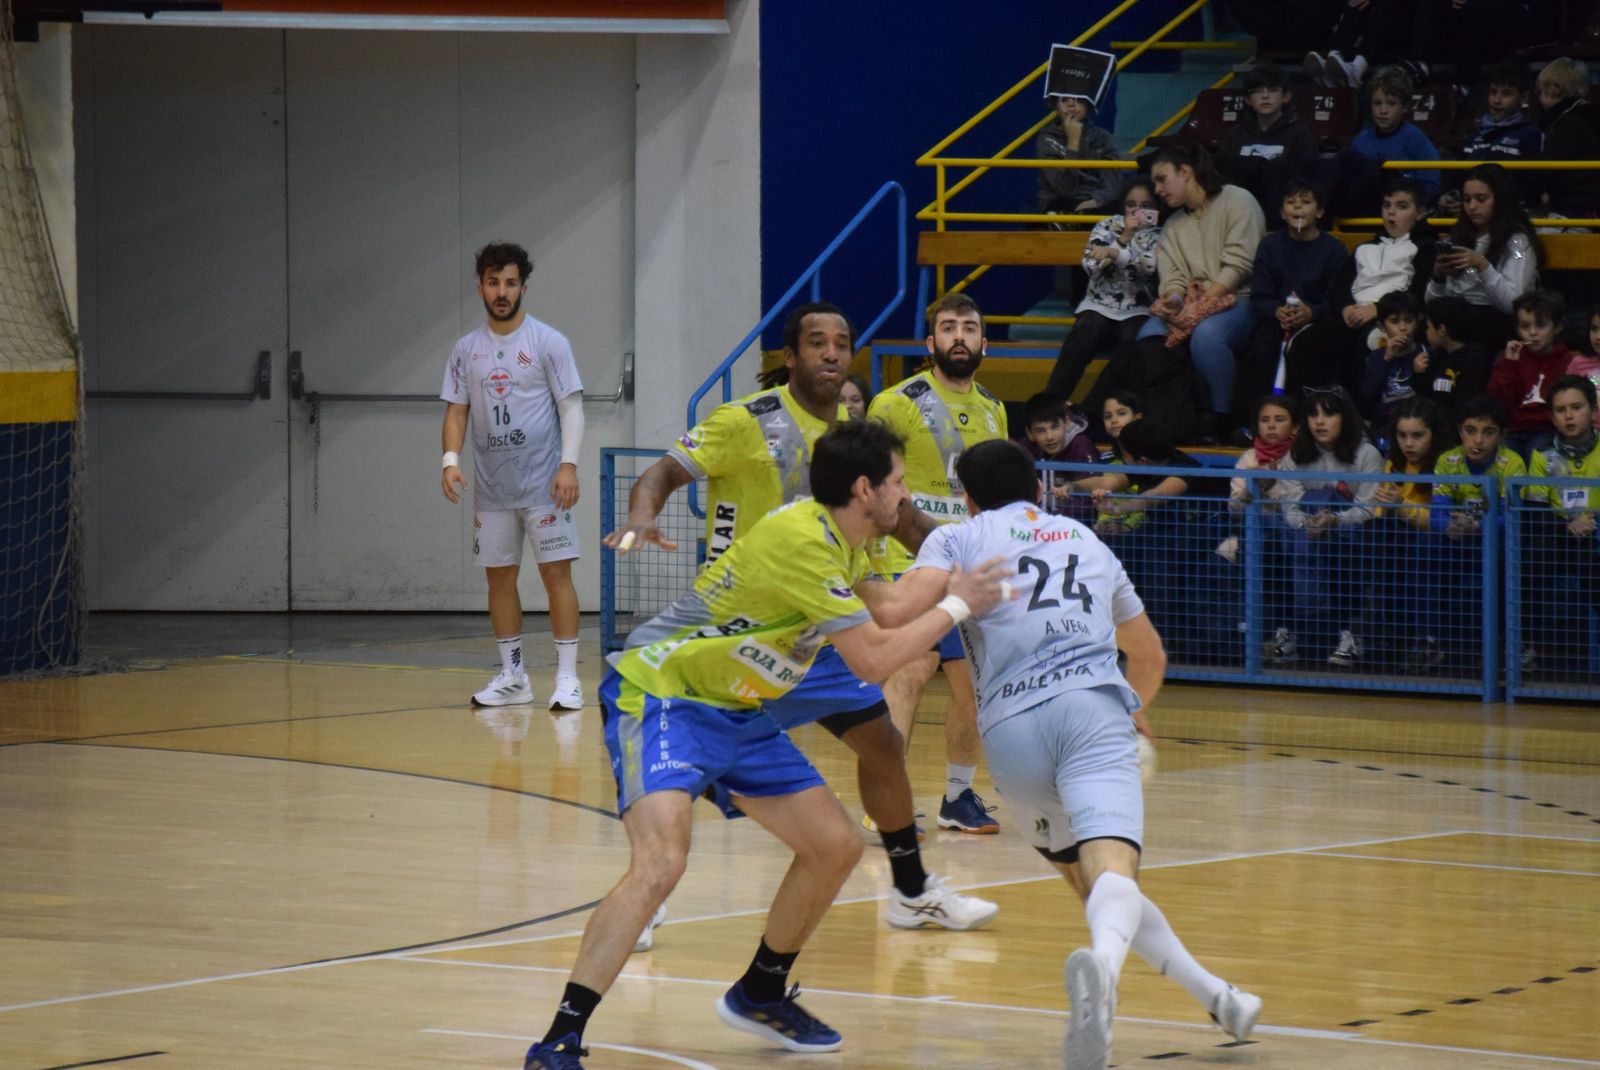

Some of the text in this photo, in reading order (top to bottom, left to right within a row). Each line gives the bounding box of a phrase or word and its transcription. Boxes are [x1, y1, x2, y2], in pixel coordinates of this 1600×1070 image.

[1313, 96, 1334, 110] 76
[493, 404, 511, 427] 16
[913, 498, 949, 514] CAJA
[1018, 553, 1094, 615] 24
[1045, 620, 1060, 635] A.
